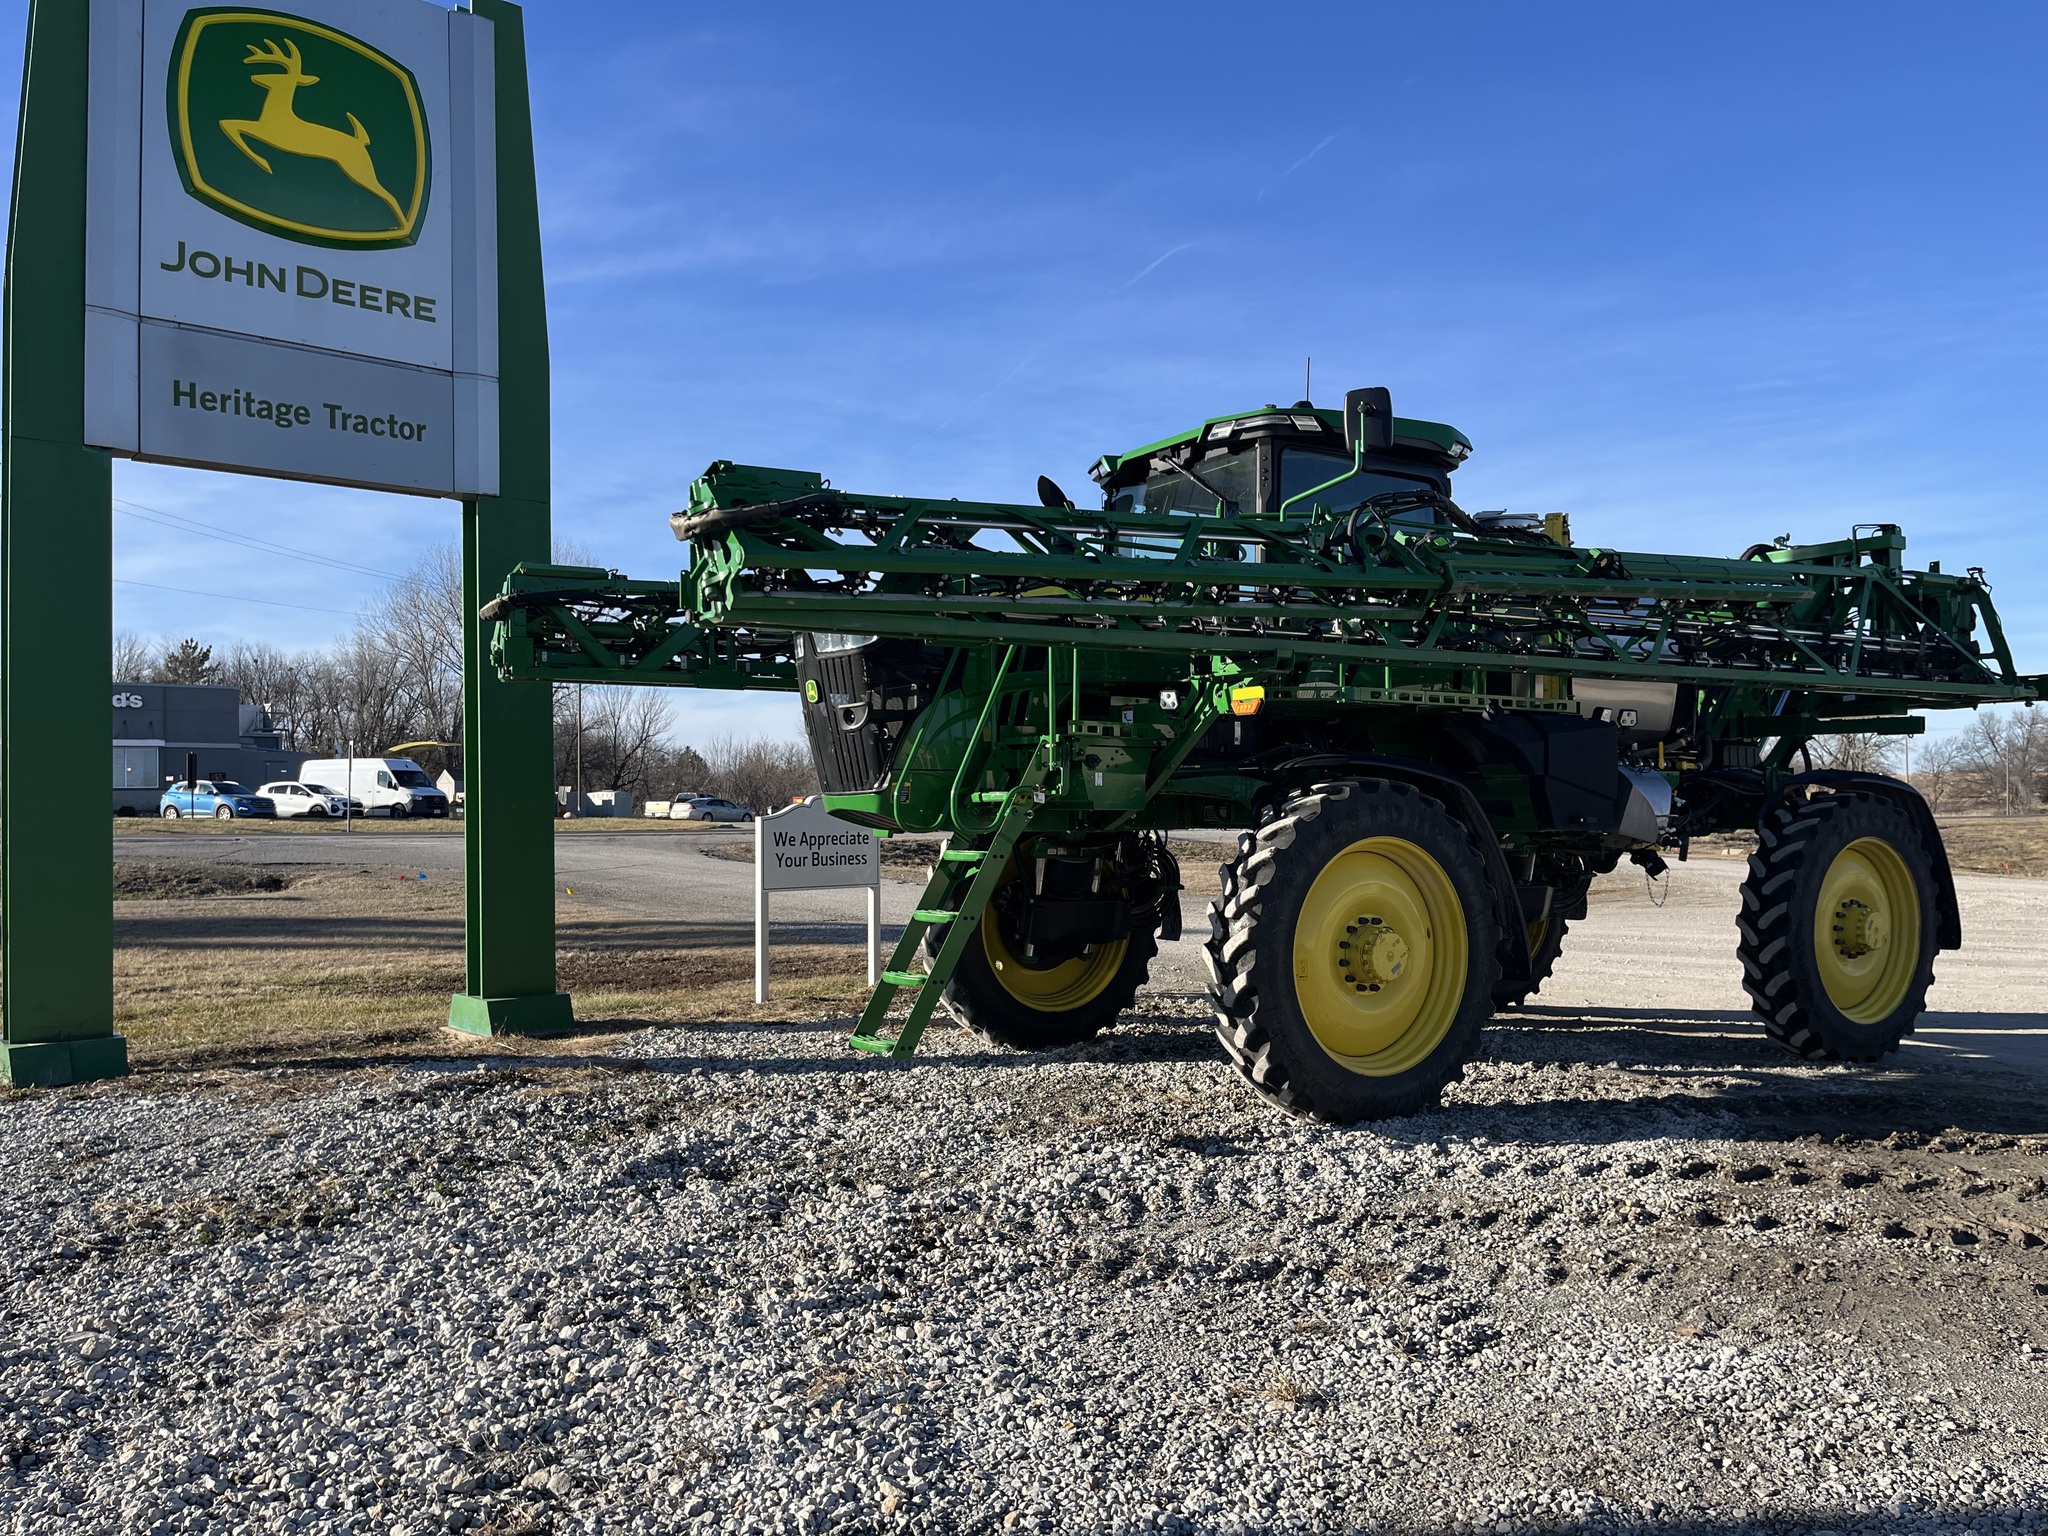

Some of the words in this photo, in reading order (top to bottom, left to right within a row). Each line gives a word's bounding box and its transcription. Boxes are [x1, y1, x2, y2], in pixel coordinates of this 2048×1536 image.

[160, 240, 287, 293] JOHN
[297, 265, 437, 324] DEERE
[173, 379, 311, 428] Heritage
[323, 402, 427, 442] Tractor
[773, 831, 796, 847] We
[799, 831, 870, 850] Appreciate
[775, 852, 808, 868] Your
[811, 851, 868, 867] Business
